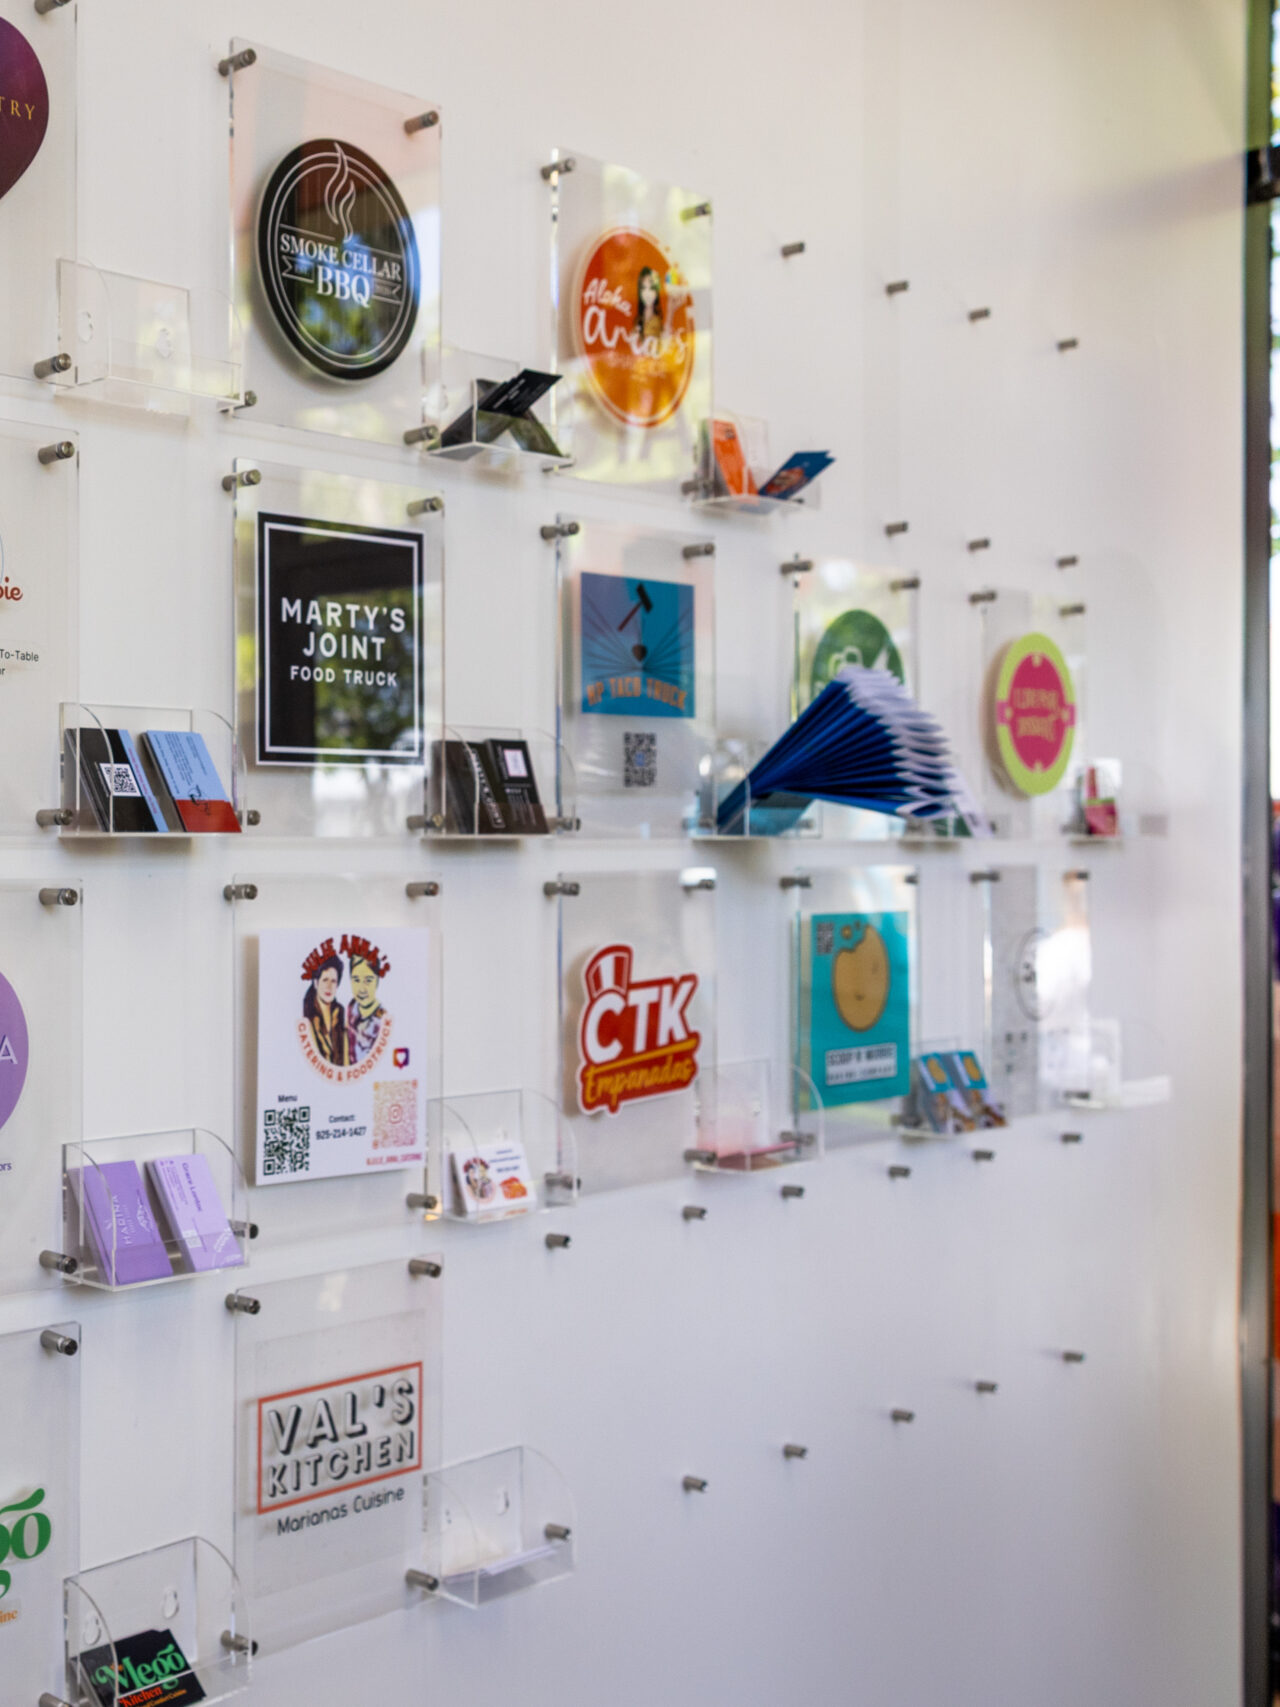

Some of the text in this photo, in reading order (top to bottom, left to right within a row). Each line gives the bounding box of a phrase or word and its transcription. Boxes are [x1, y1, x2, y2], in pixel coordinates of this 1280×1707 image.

[280, 232, 403, 282] SMOKE CELLAR
[316, 264, 371, 309] BBQ
[583, 277, 632, 317] Aloha
[280, 597, 407, 633] MARTY'S
[302, 631, 386, 662] JOINT
[290, 665, 398, 688] FOOD TRUCK
[584, 979, 697, 1065] CTK
[298, 1022, 334, 1080] CATERING
[277, 1094, 298, 1103] Menu
[585, 1054, 696, 1107] Empanadas
[267, 1377, 415, 1456] VAL'S
[268, 1429, 415, 1498] KITCHEN
[276, 1487, 405, 1537] Marianas Cuisine
